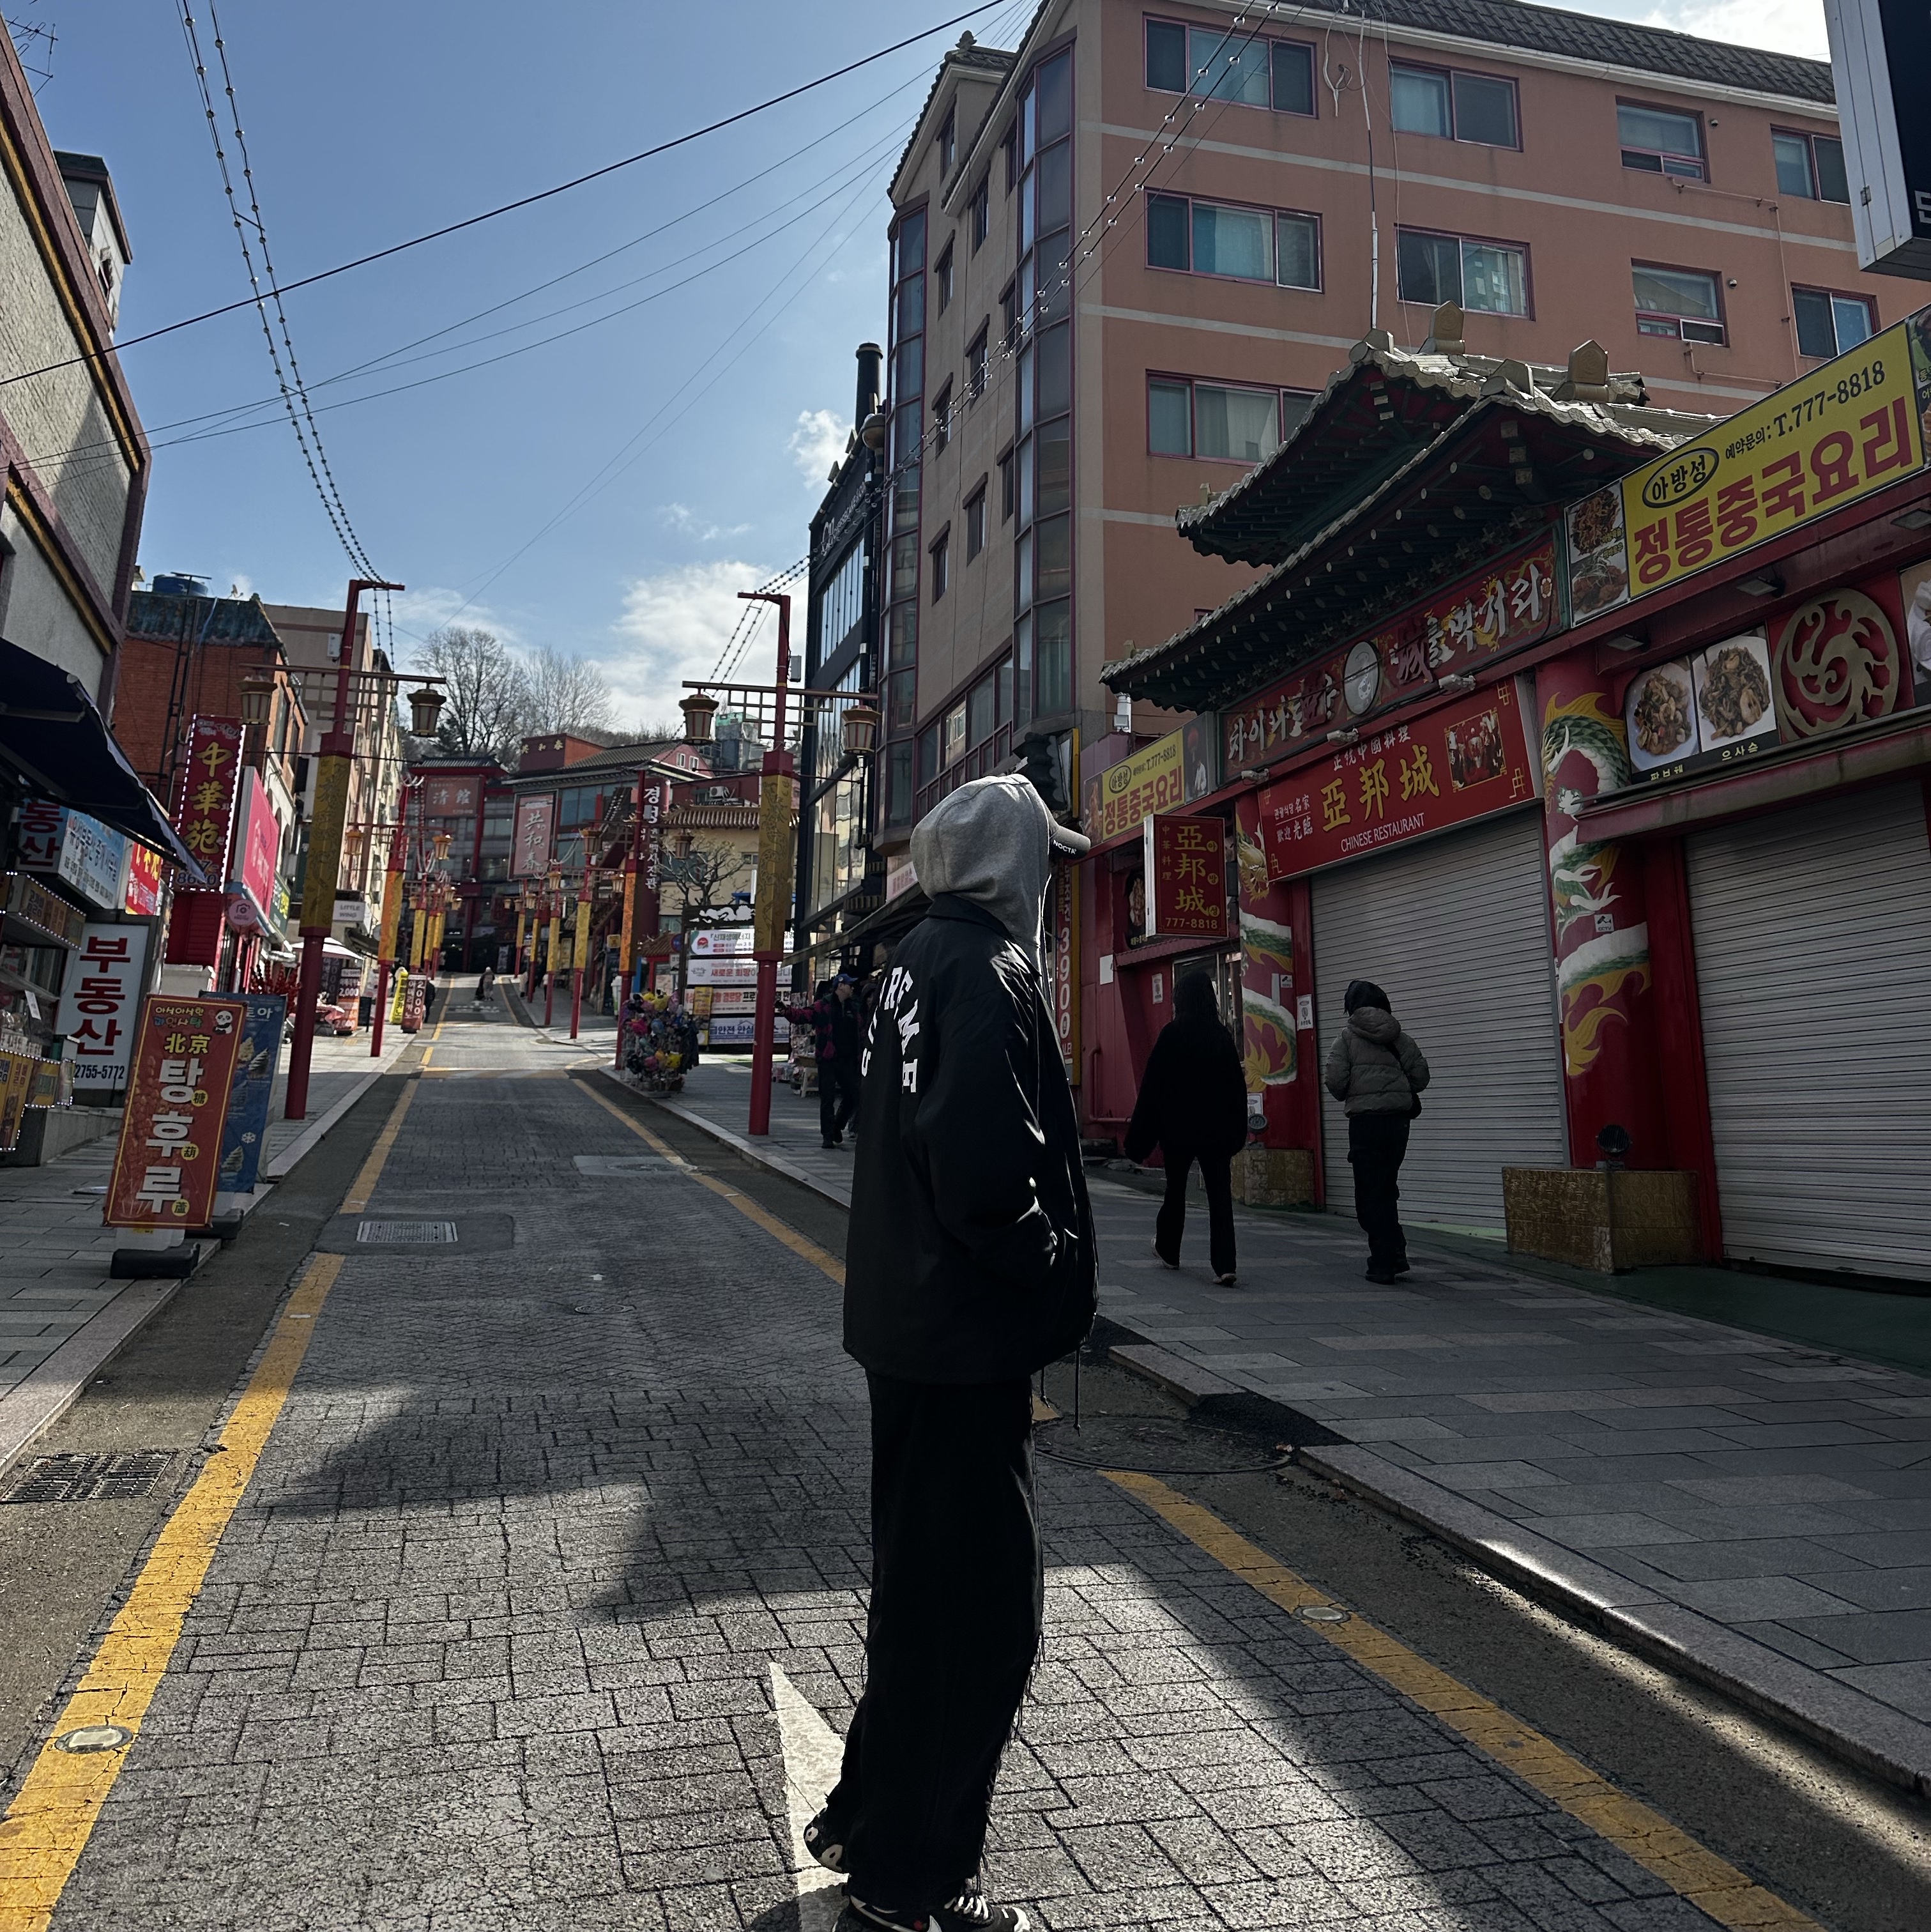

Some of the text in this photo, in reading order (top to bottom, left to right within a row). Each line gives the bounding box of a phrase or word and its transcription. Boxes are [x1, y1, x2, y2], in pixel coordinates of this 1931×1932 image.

[1652, 455, 1707, 501] 아방성
[1774, 360, 1886, 438] T.777-8818
[1634, 396, 1914, 585] 정통중국요리
[183, 740, 234, 855] 中華苑
[1104, 765, 1182, 836] 정통중국요리
[1320, 743, 1441, 833] 亞邦城
[1340, 812, 1426, 853] CHINESE RESTAURANT
[521, 809, 545, 871] 共和春
[1053, 839, 1076, 855] NOCTA
[1173, 824, 1210, 917] 亞邦城
[1165, 916, 1218, 930] 777-8818
[72, 935, 131, 1056] 부동산
[164, 1032, 211, 1055] 北京
[135, 1058, 205, 1215] 탕후루
